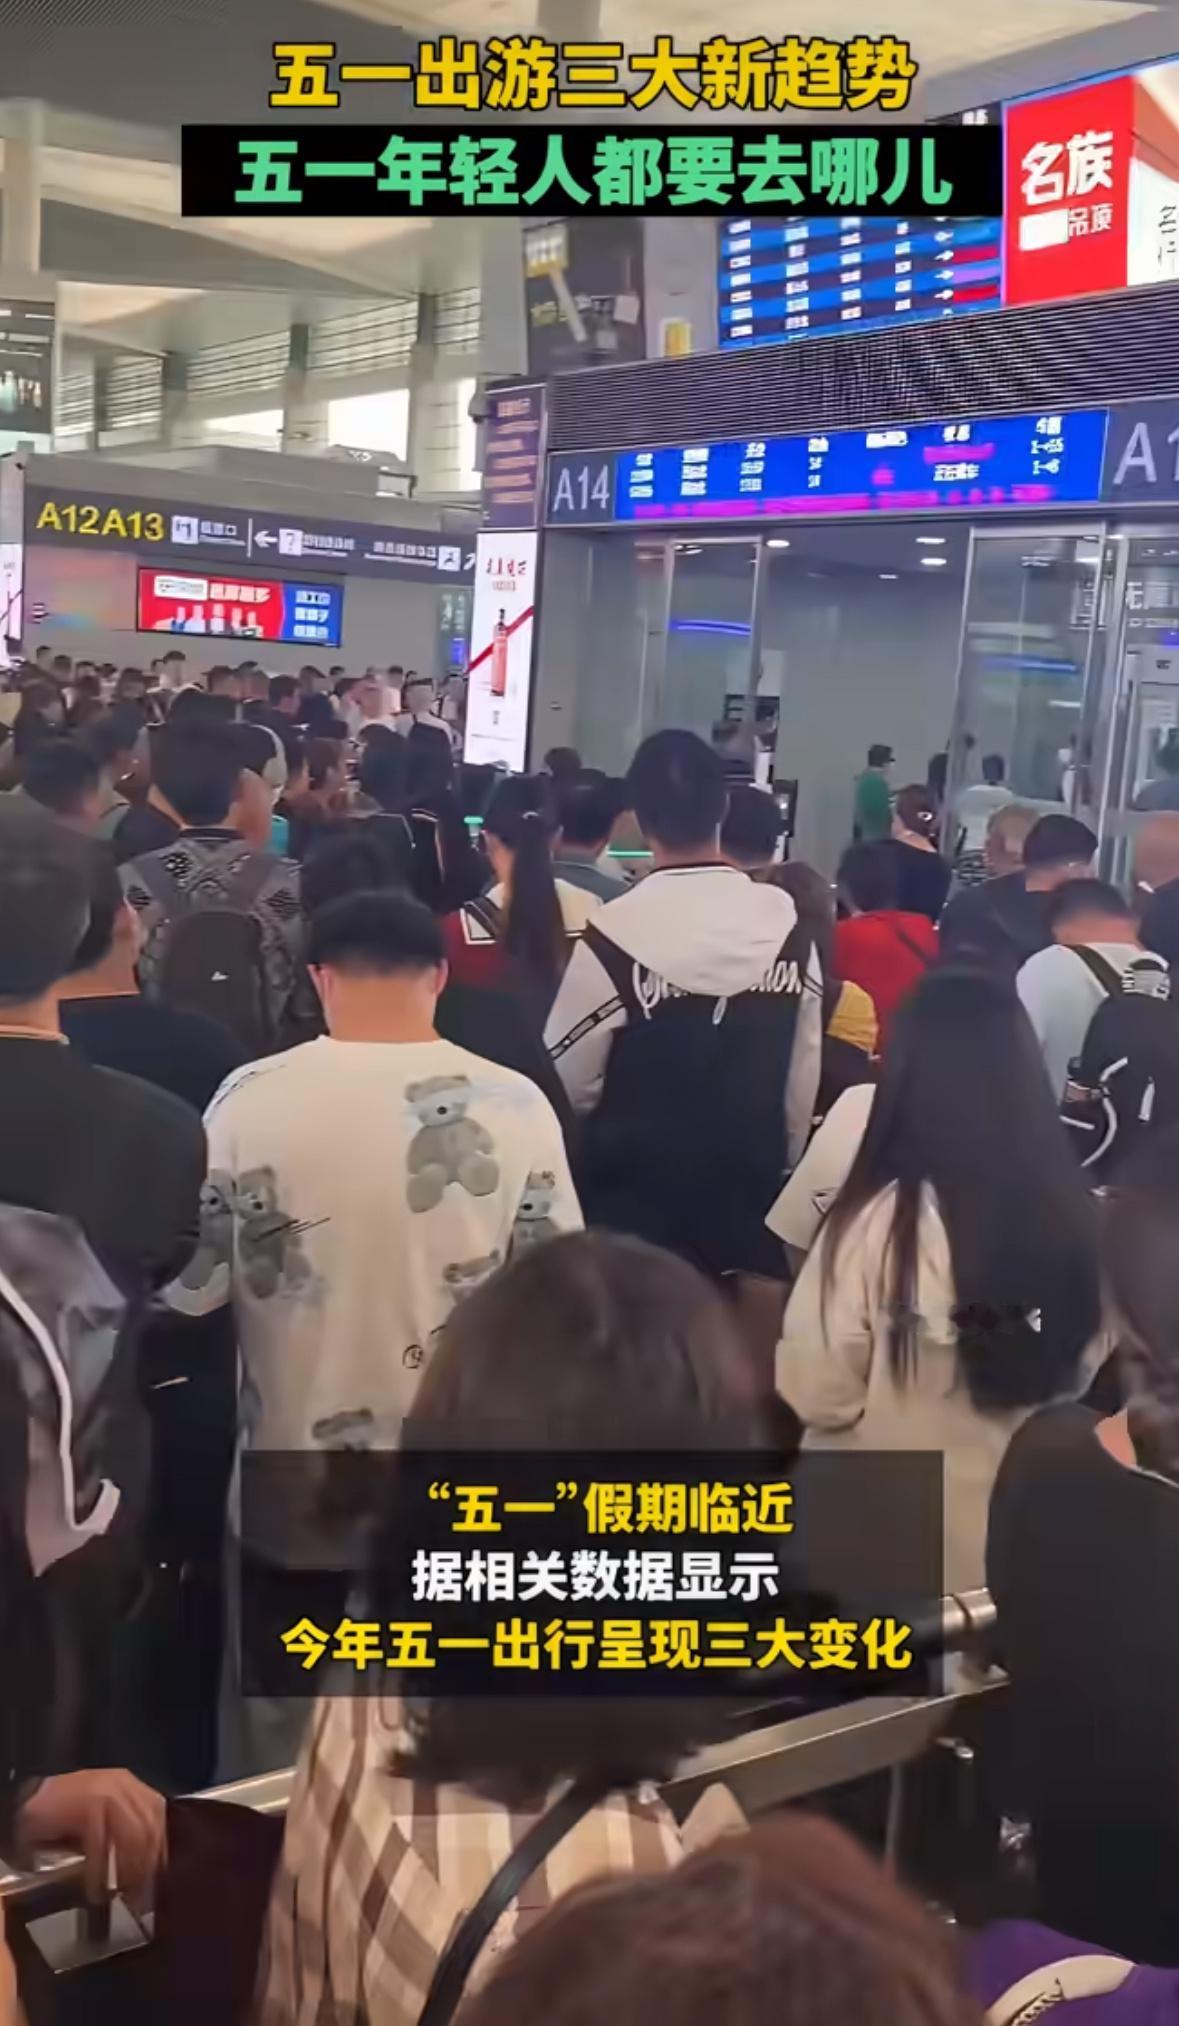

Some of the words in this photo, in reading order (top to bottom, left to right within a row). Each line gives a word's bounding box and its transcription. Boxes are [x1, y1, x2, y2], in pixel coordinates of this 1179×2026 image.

[1021, 130, 1114, 207] 名族
[1068, 203, 1113, 237] 吊顶
[552, 464, 610, 512] A14
